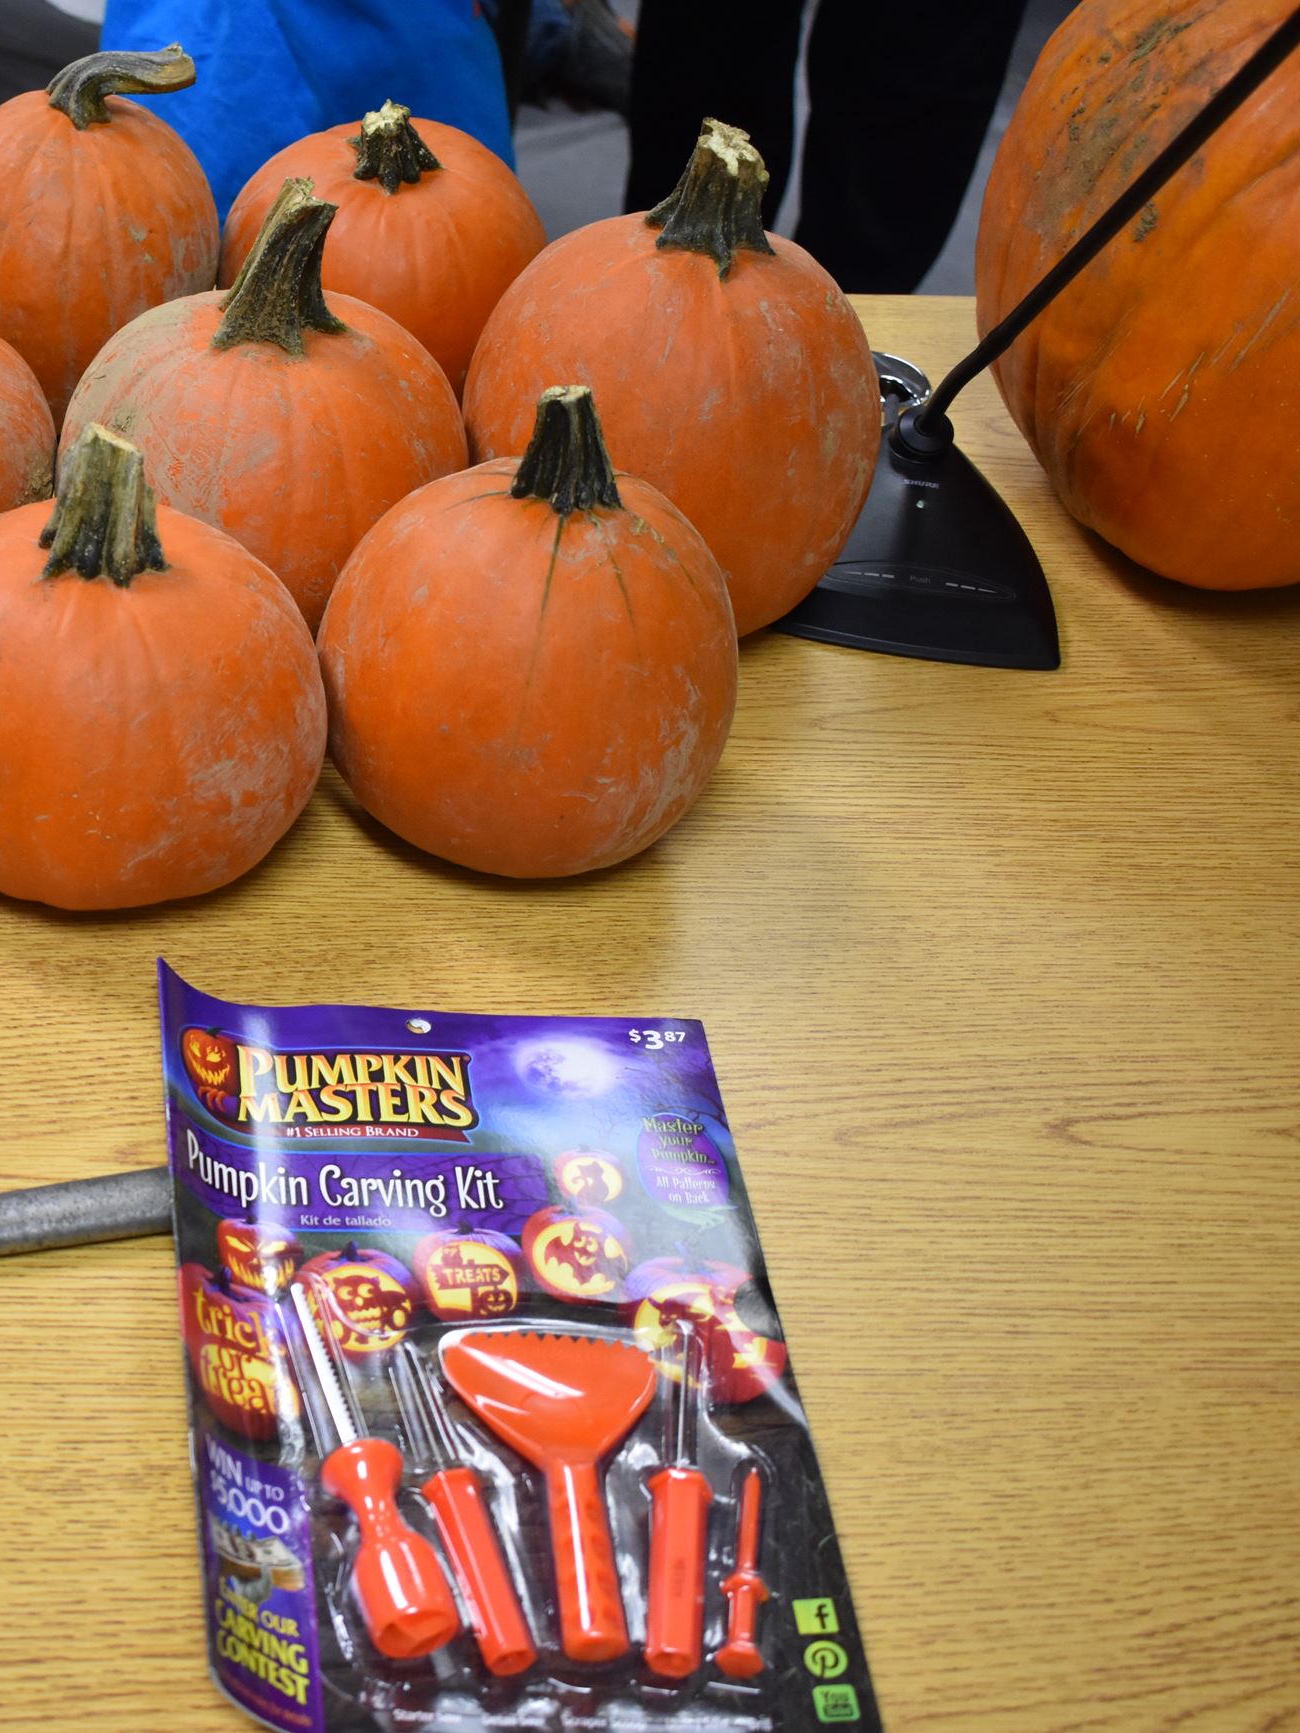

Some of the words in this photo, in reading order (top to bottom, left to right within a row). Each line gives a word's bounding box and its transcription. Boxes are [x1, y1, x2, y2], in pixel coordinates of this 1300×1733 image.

[238, 1045, 466, 1097] PUMPKIN
[237, 1082, 474, 1128] MASTERS
[287, 1127, 300, 1137] #1
[305, 1126, 361, 1138] SELLING
[366, 1125, 419, 1138] BRAND
[643, 1117, 704, 1136] Master
[659, 1135, 693, 1148] your
[186, 1128, 309, 1208] Pumpkin
[319, 1164, 447, 1217] Carving
[455, 1166, 504, 1210] Kit
[655, 1175, 669, 1188] All
[672, 1176, 716, 1189] Patterns
[669, 1192, 683, 1204] on
[686, 1191, 711, 1205] Back
[300, 1213, 317, 1226] Kit
[324, 1214, 341, 1226] de
[345, 1213, 392, 1227] tallado
[442, 1267, 501, 1285] TREATS
[205, 1433, 243, 1488] WIN
[245, 1477, 264, 1497] UP
[265, 1482, 285, 1502] TO
[209, 1469, 291, 1535] $5,000
[215, 1598, 310, 1674] CARVING
[261, 1610, 300, 1638] OUR
[215, 1630, 310, 1706] CONTEST
